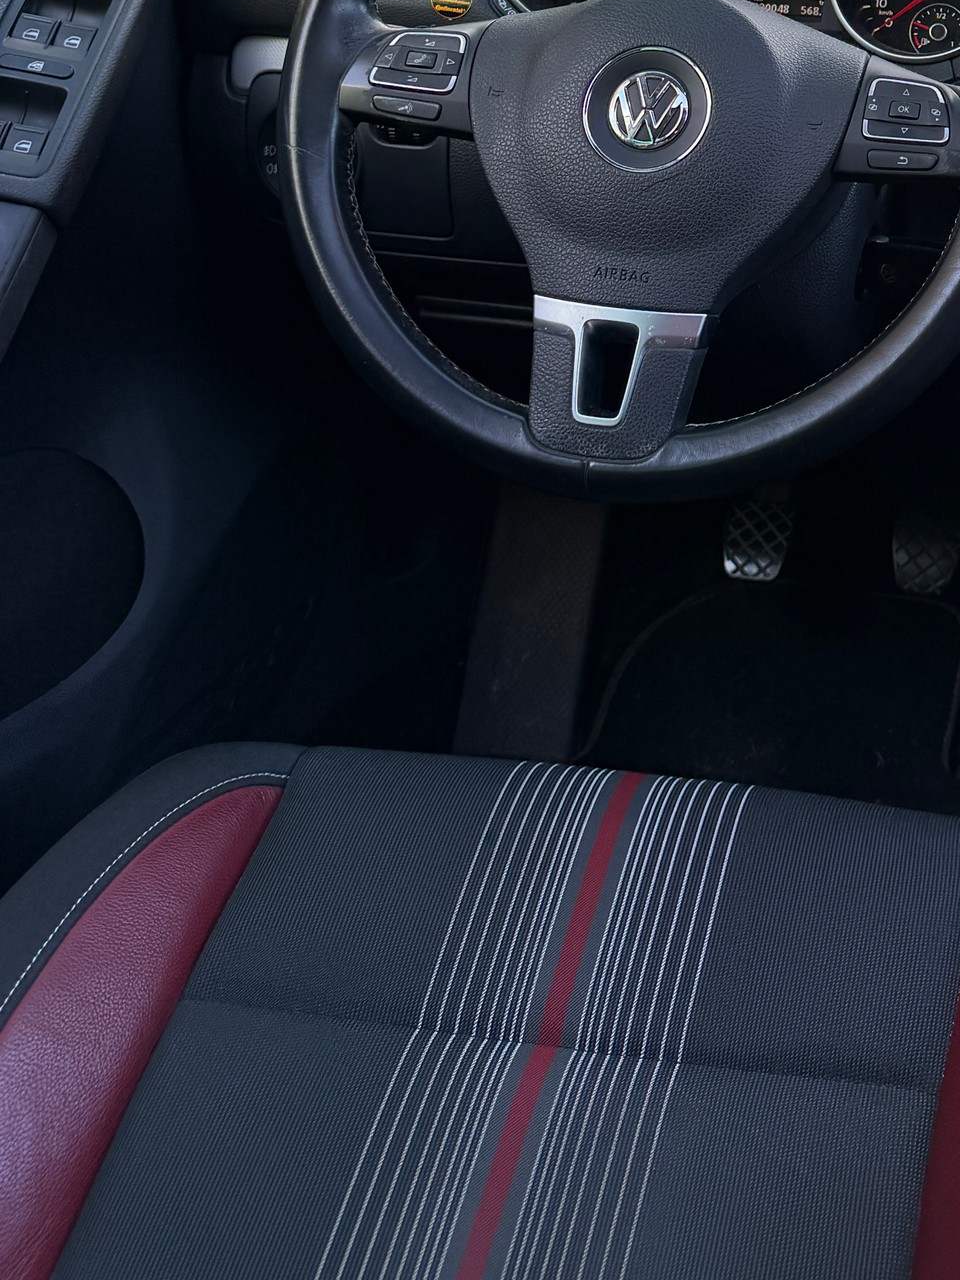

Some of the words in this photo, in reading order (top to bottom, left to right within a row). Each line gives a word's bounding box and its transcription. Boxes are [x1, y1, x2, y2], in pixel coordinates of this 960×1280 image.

[936, 12, 947, 20] 1/2
[898, 105, 910, 114] OK
[593, 267, 652, 283] AIRBAG
